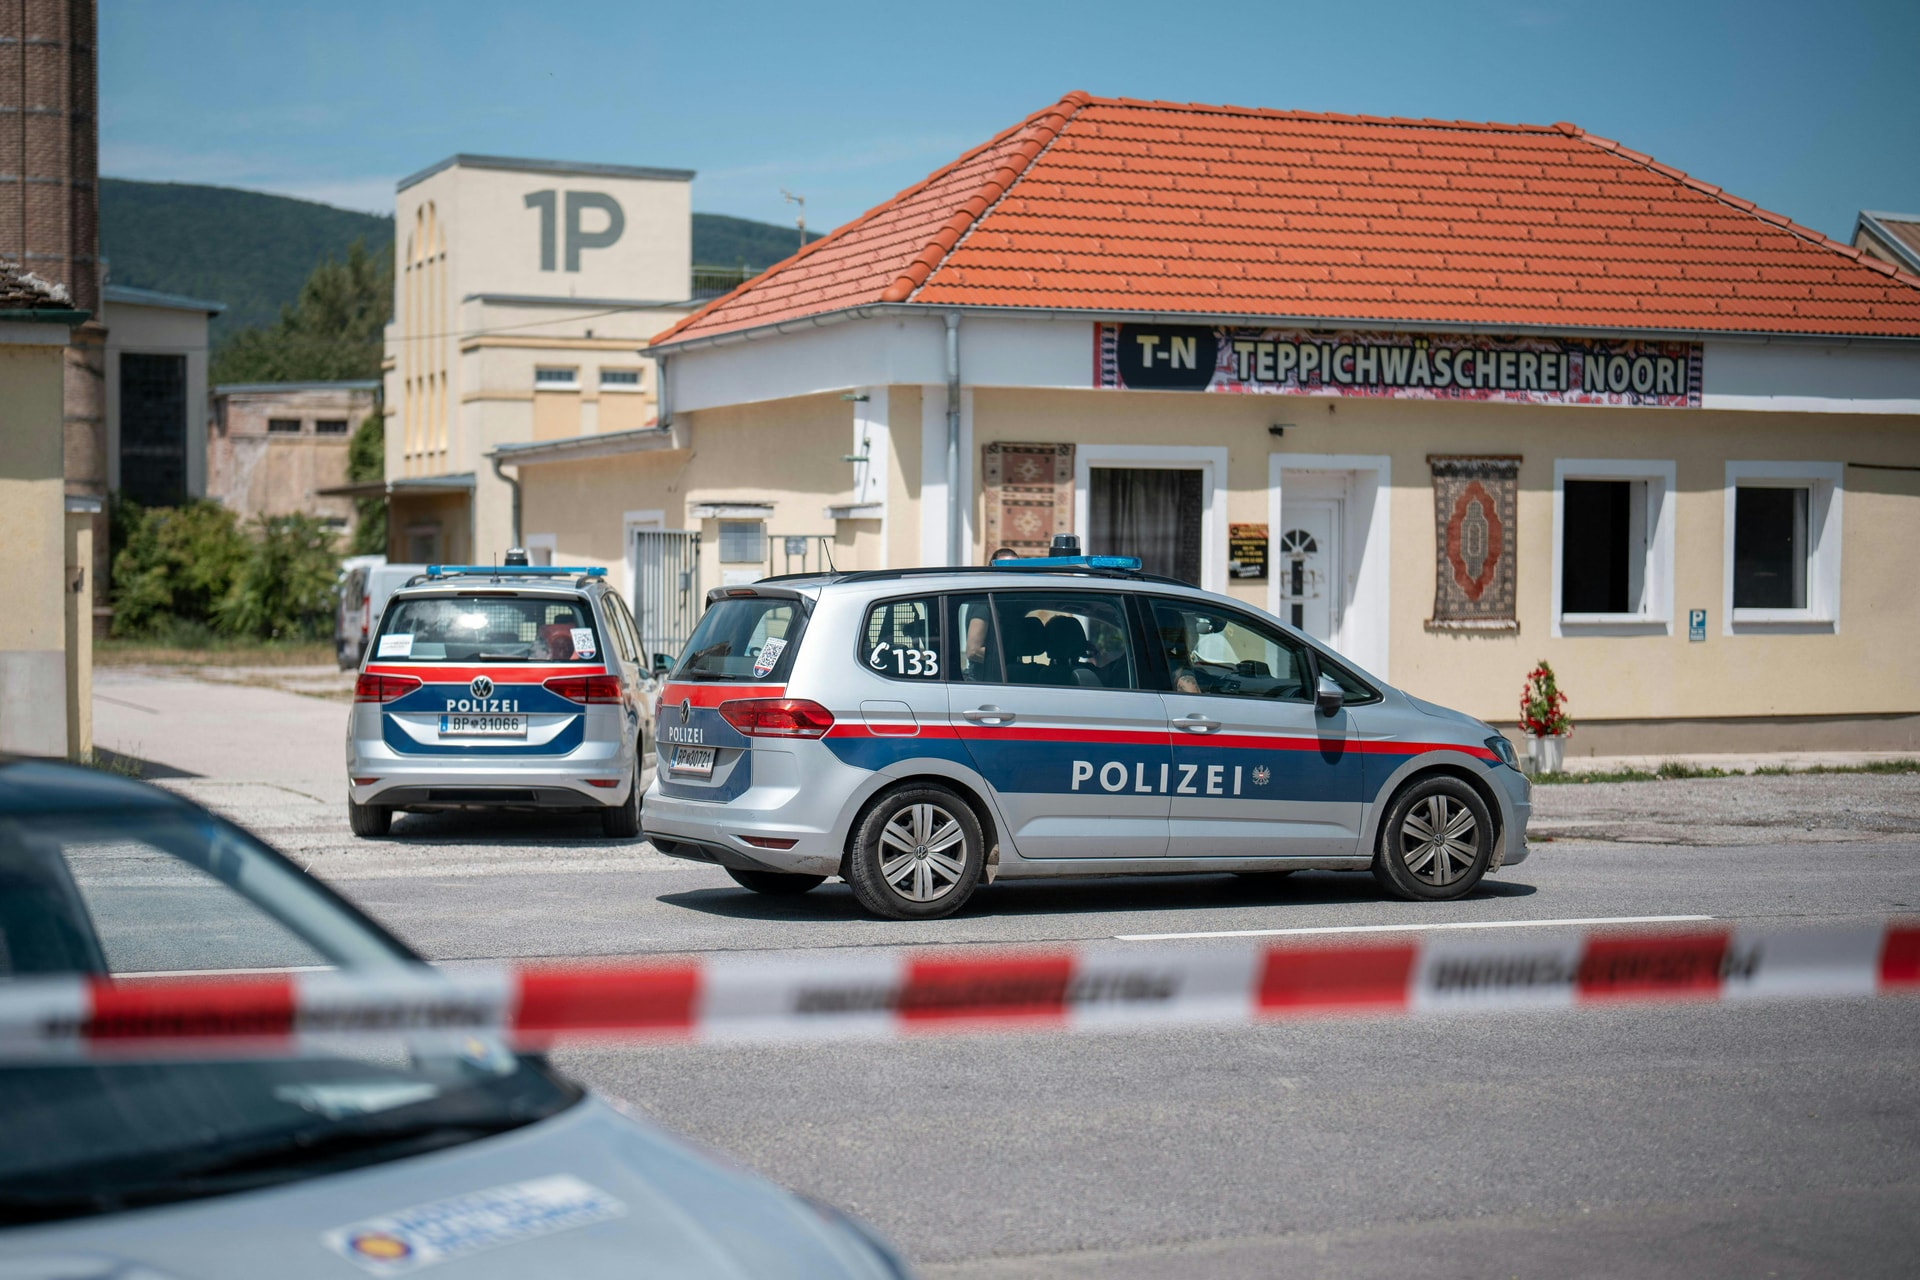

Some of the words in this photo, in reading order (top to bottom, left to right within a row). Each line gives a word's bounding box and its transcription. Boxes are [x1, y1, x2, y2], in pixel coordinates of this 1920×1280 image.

[523, 189, 626, 273] 1P
[1136, 334, 1197, 370] T-N
[1231, 339, 1569, 391] TEPPICHWÄSCHEREI
[1583, 353, 1687, 395] NOORI
[1693, 611, 1704, 627] P
[892, 648, 939, 676] 133
[446, 699, 519, 713] POLIZEI
[669, 726, 703, 744] POLIZEI
[1071, 760, 1243, 796] POLIZEI
